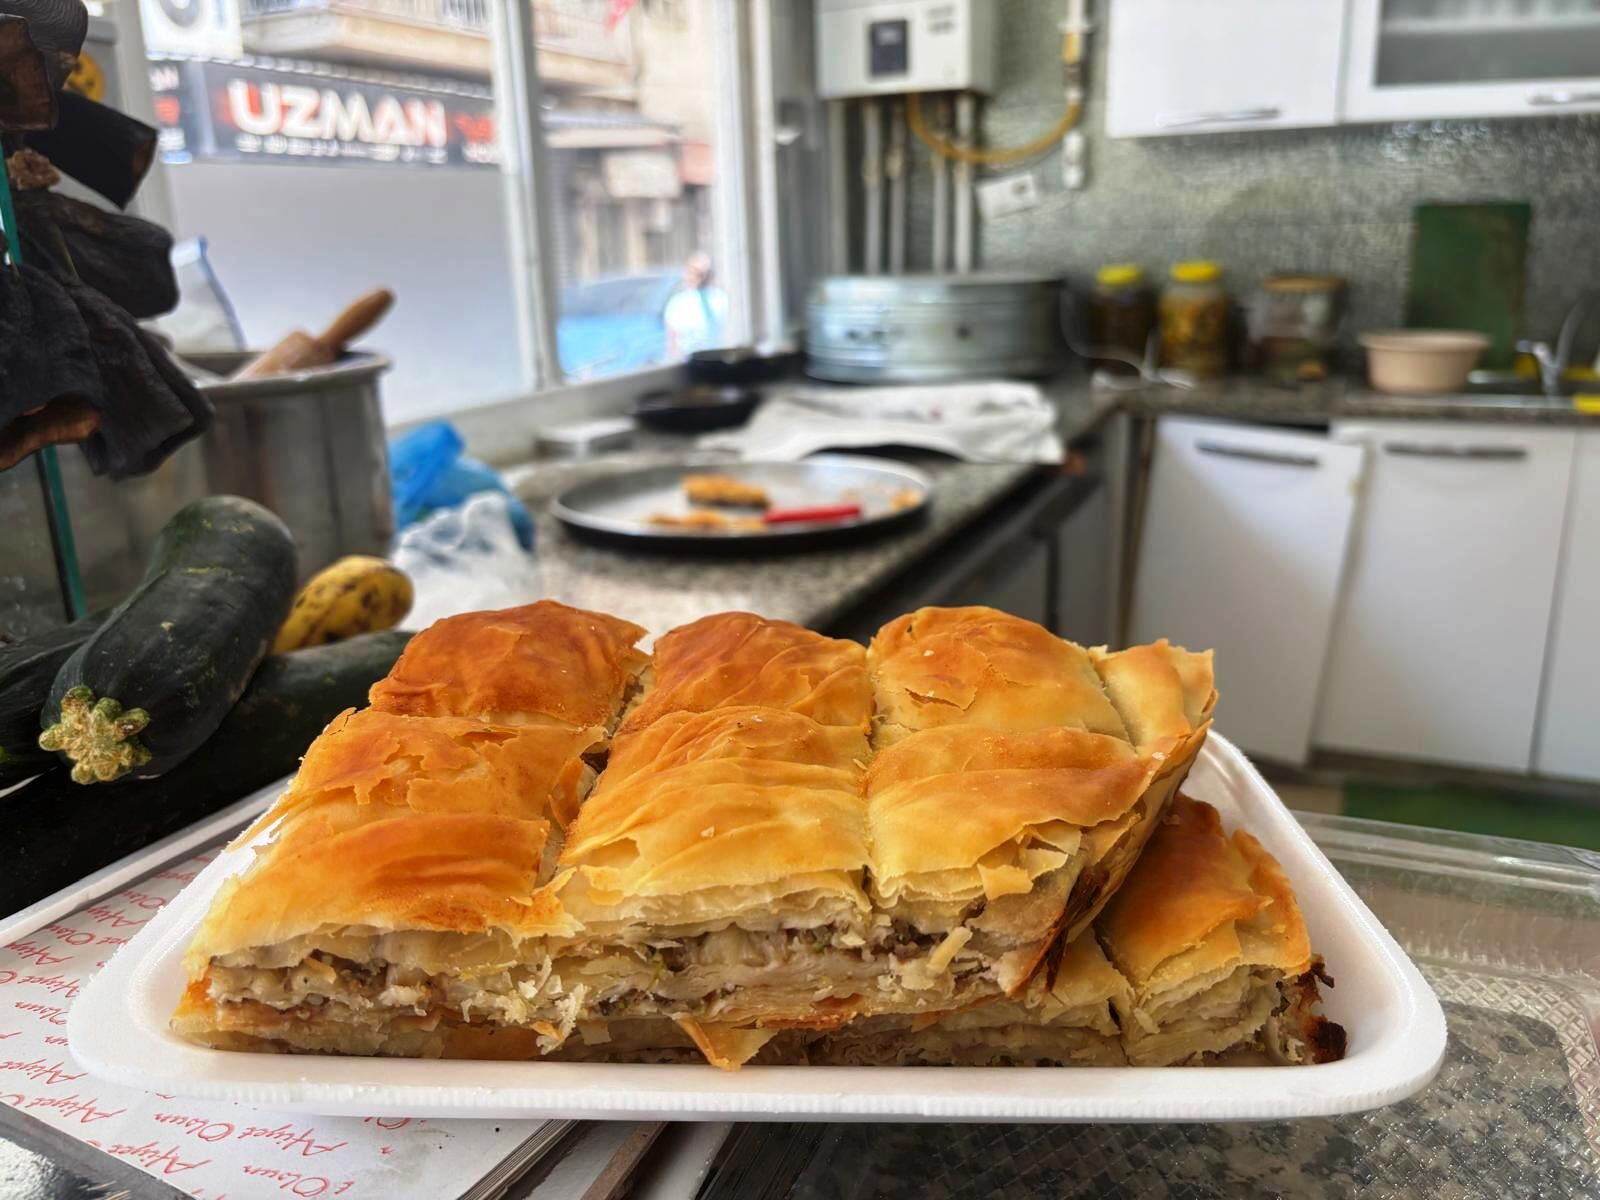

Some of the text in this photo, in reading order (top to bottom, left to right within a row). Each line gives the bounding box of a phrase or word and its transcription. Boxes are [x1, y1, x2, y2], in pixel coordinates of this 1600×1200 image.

[227, 79, 447, 147] UZMAN
[25, 1094, 128, 1123] Afiyet
[153, 1112, 236, 1143] Olsun
[238, 1123, 349, 1157] Afiyet
[242, 1164, 331, 1198] Olsun
